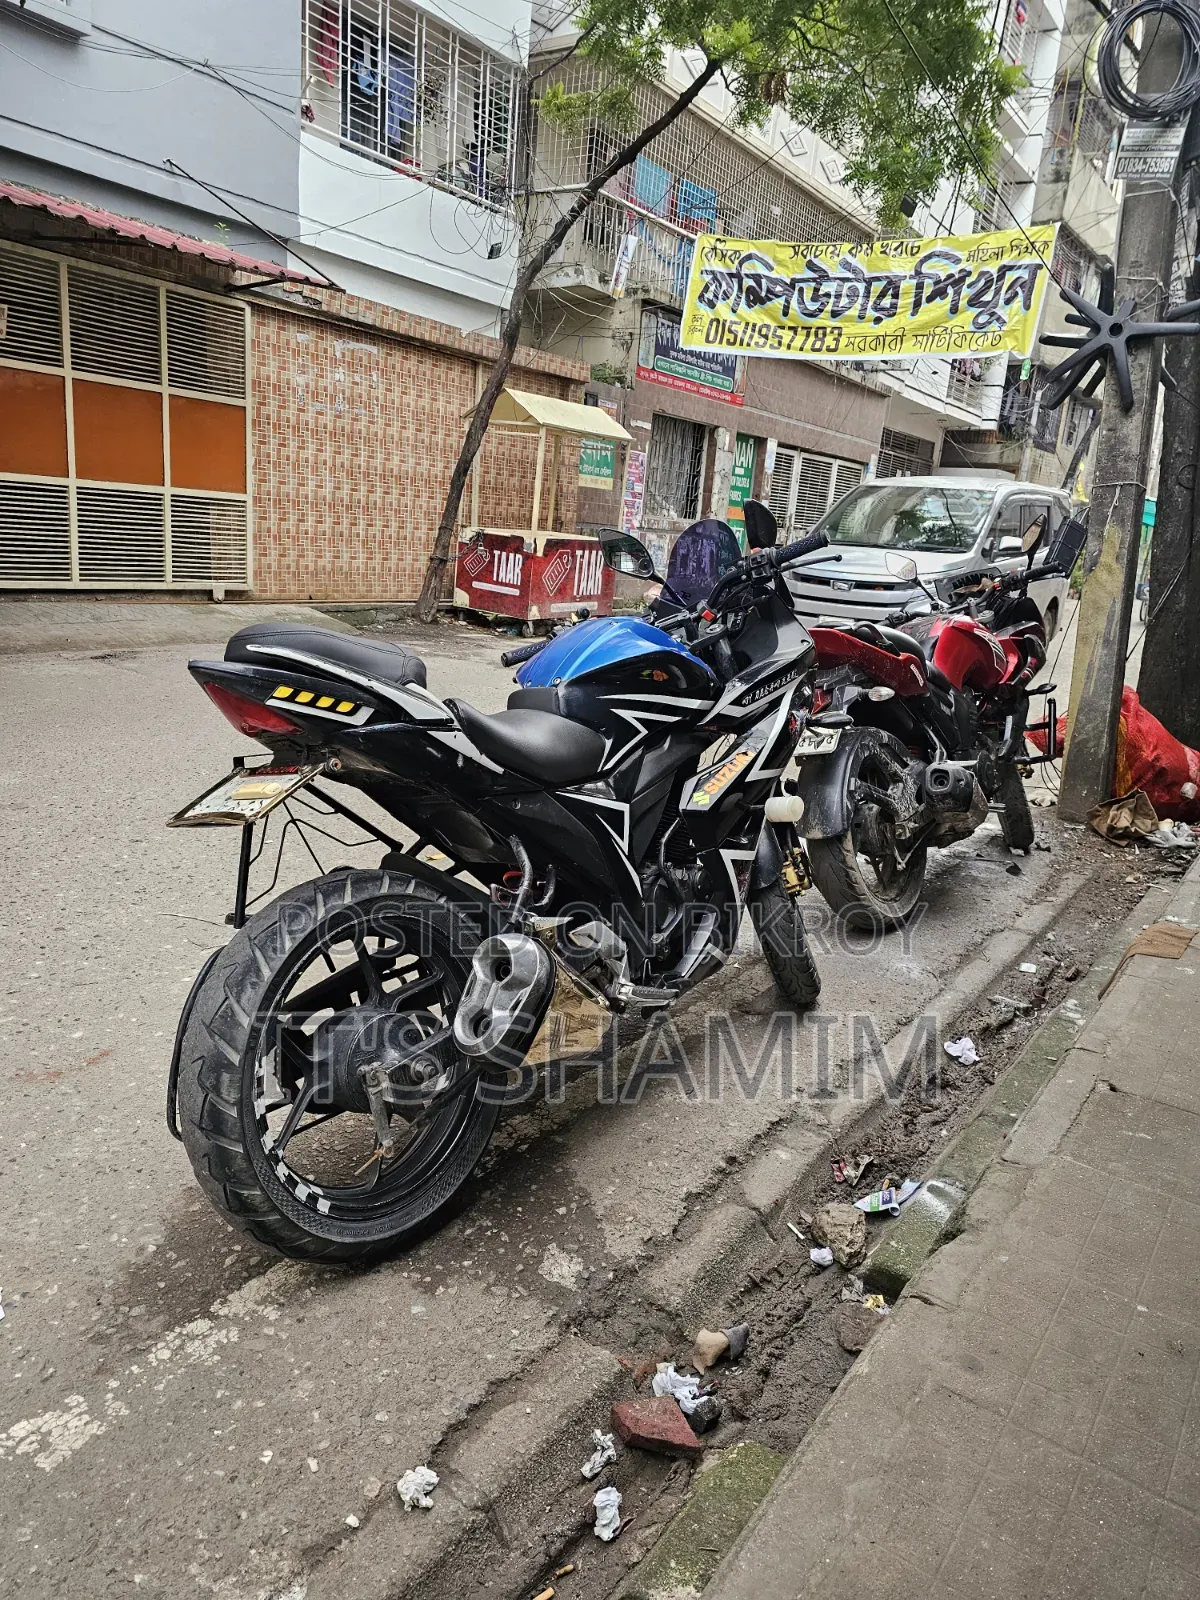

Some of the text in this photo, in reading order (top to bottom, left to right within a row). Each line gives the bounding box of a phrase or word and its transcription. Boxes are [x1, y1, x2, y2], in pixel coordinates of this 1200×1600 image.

[1118, 157, 1175, 173] 01834-753961
[788, 243, 844, 260] সবচেয়ে
[965, 242, 1006, 264] মহিলা
[909, 250, 1044, 330] শিখুন
[704, 317, 843, 353] 01511957783
[493, 550, 523, 586] TAAR
[573, 550, 604, 596] TAAR
